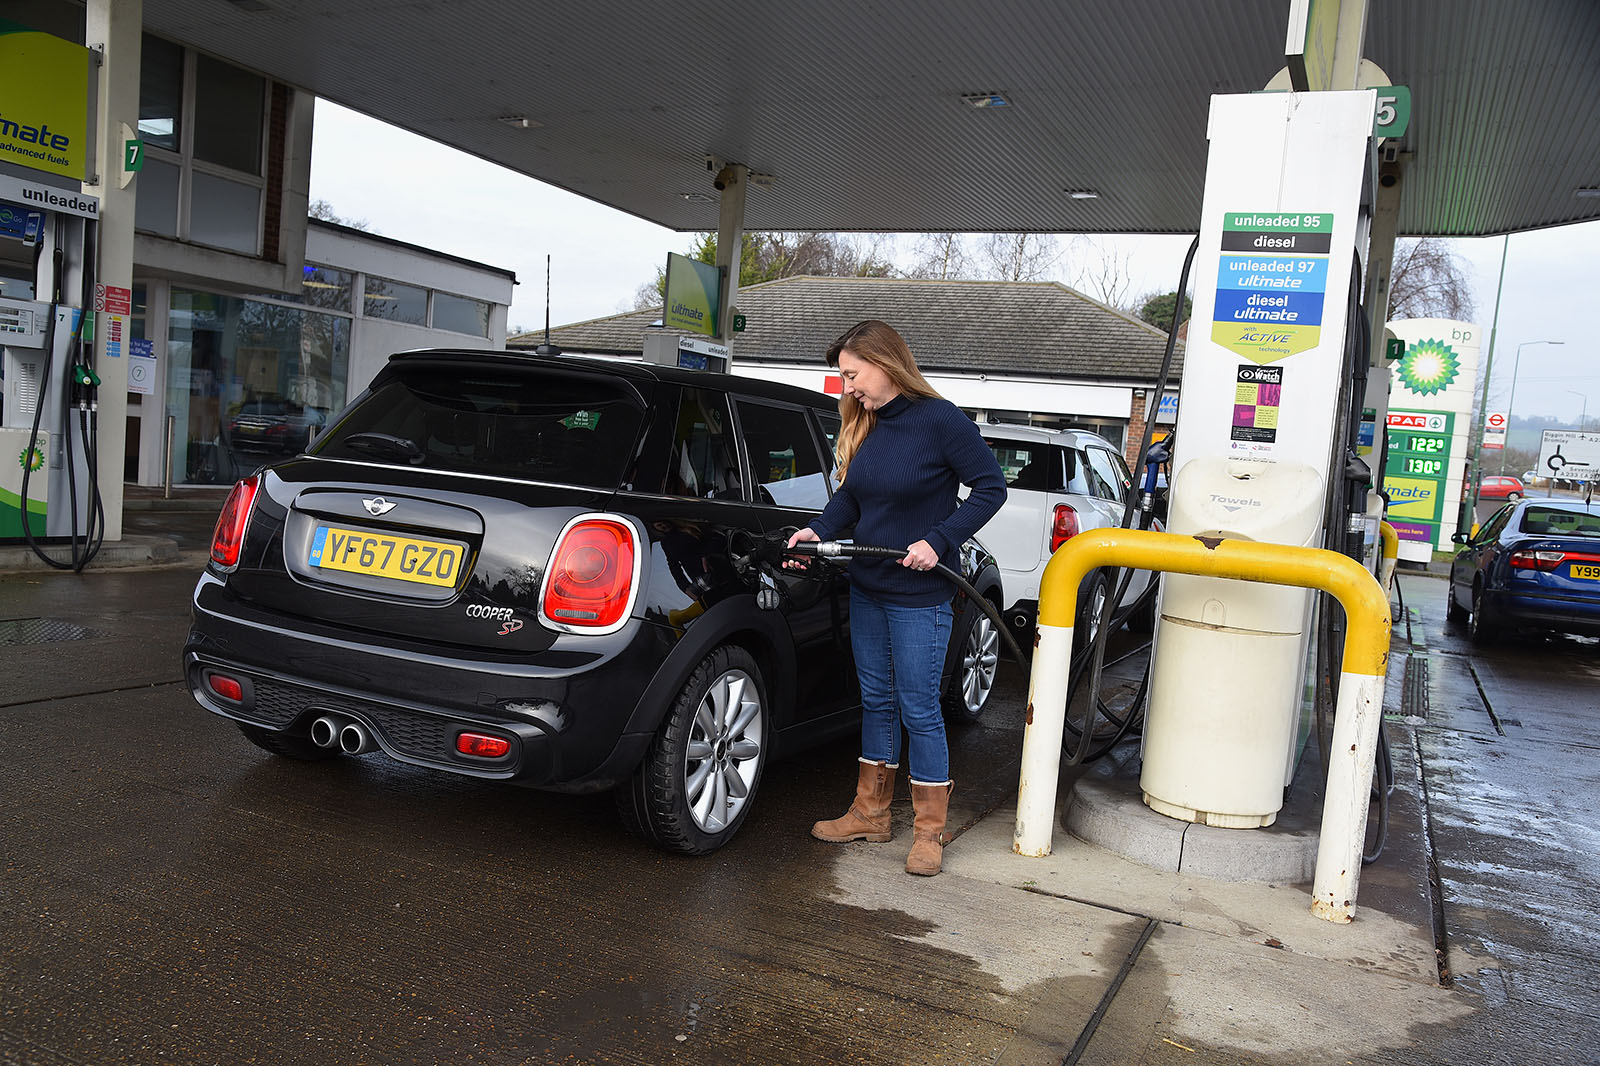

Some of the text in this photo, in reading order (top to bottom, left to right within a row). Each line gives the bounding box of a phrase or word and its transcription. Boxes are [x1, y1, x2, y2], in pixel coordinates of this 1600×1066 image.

[1376, 96, 1397, 126] 5
[0, 113, 70, 152] mate
[0, 142, 69, 167] advanced fuels
[129, 146, 139, 165] 7
[22, 188, 97, 214] unleaded
[1234, 214, 1321, 228] unleaded 95
[1253, 235, 1296, 248] diesel
[1229, 259, 1316, 273] unleaded 97
[1238, 275, 1303, 288] ultimate
[1246, 294, 1289, 307] diesel
[59, 314, 65, 322] 7
[671, 303, 704, 320] ultimate
[1233, 307, 1299, 321] ultimate
[736, 319, 743, 328] 3
[1238, 333, 1292, 344] ACTIVE
[1451, 328, 1472, 343] bp
[680, 340, 695, 348] diesel
[1392, 343, 1399, 355] 1
[1255, 371, 1280, 380] Watch
[1384, 484, 1431, 498] imate
[1209, 494, 1262, 506] Towels
[330, 533, 397, 570] YF67
[1575, 566, 1600, 578] Y99
[465, 603, 514, 621] COOPER
[496, 618, 524, 635] SD
